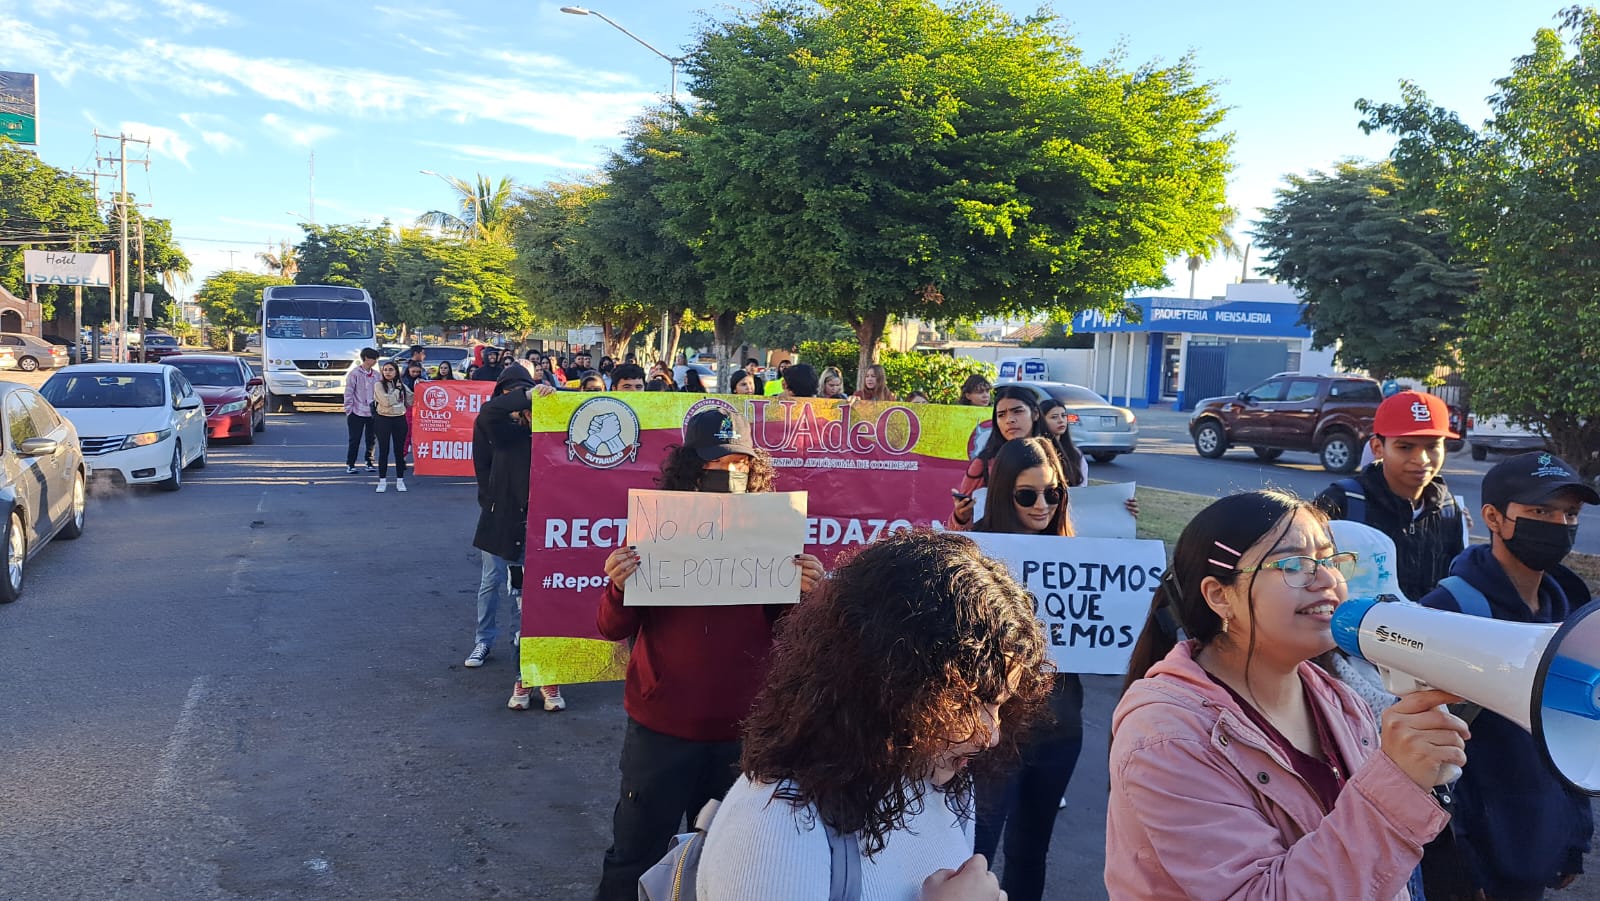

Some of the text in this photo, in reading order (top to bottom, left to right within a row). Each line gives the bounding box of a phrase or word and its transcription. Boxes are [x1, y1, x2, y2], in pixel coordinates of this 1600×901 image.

[46, 252, 77, 265] Hotel
[26, 272, 109, 286] ISABEL
[1154, 308, 1272, 324] PAQUETERIA MENSAJERIA
[319, 351, 329, 359] 23
[420, 409, 452, 420] UAdeO
[749, 399, 921, 455] UAdeO
[770, 457, 804, 468] RSIDAD
[635, 495, 726, 544] No al
[544, 518, 628, 548] RECT
[803, 518, 913, 545] EDAZO
[541, 572, 611, 593] #Repos
[633, 552, 798, 593] NEPOTISMO
[1022, 560, 1164, 593] PEDIMOS
[1045, 592, 1105, 622] QUE
[1050, 623, 1134, 649] EMOS
[1390, 631, 1424, 651] Steren
